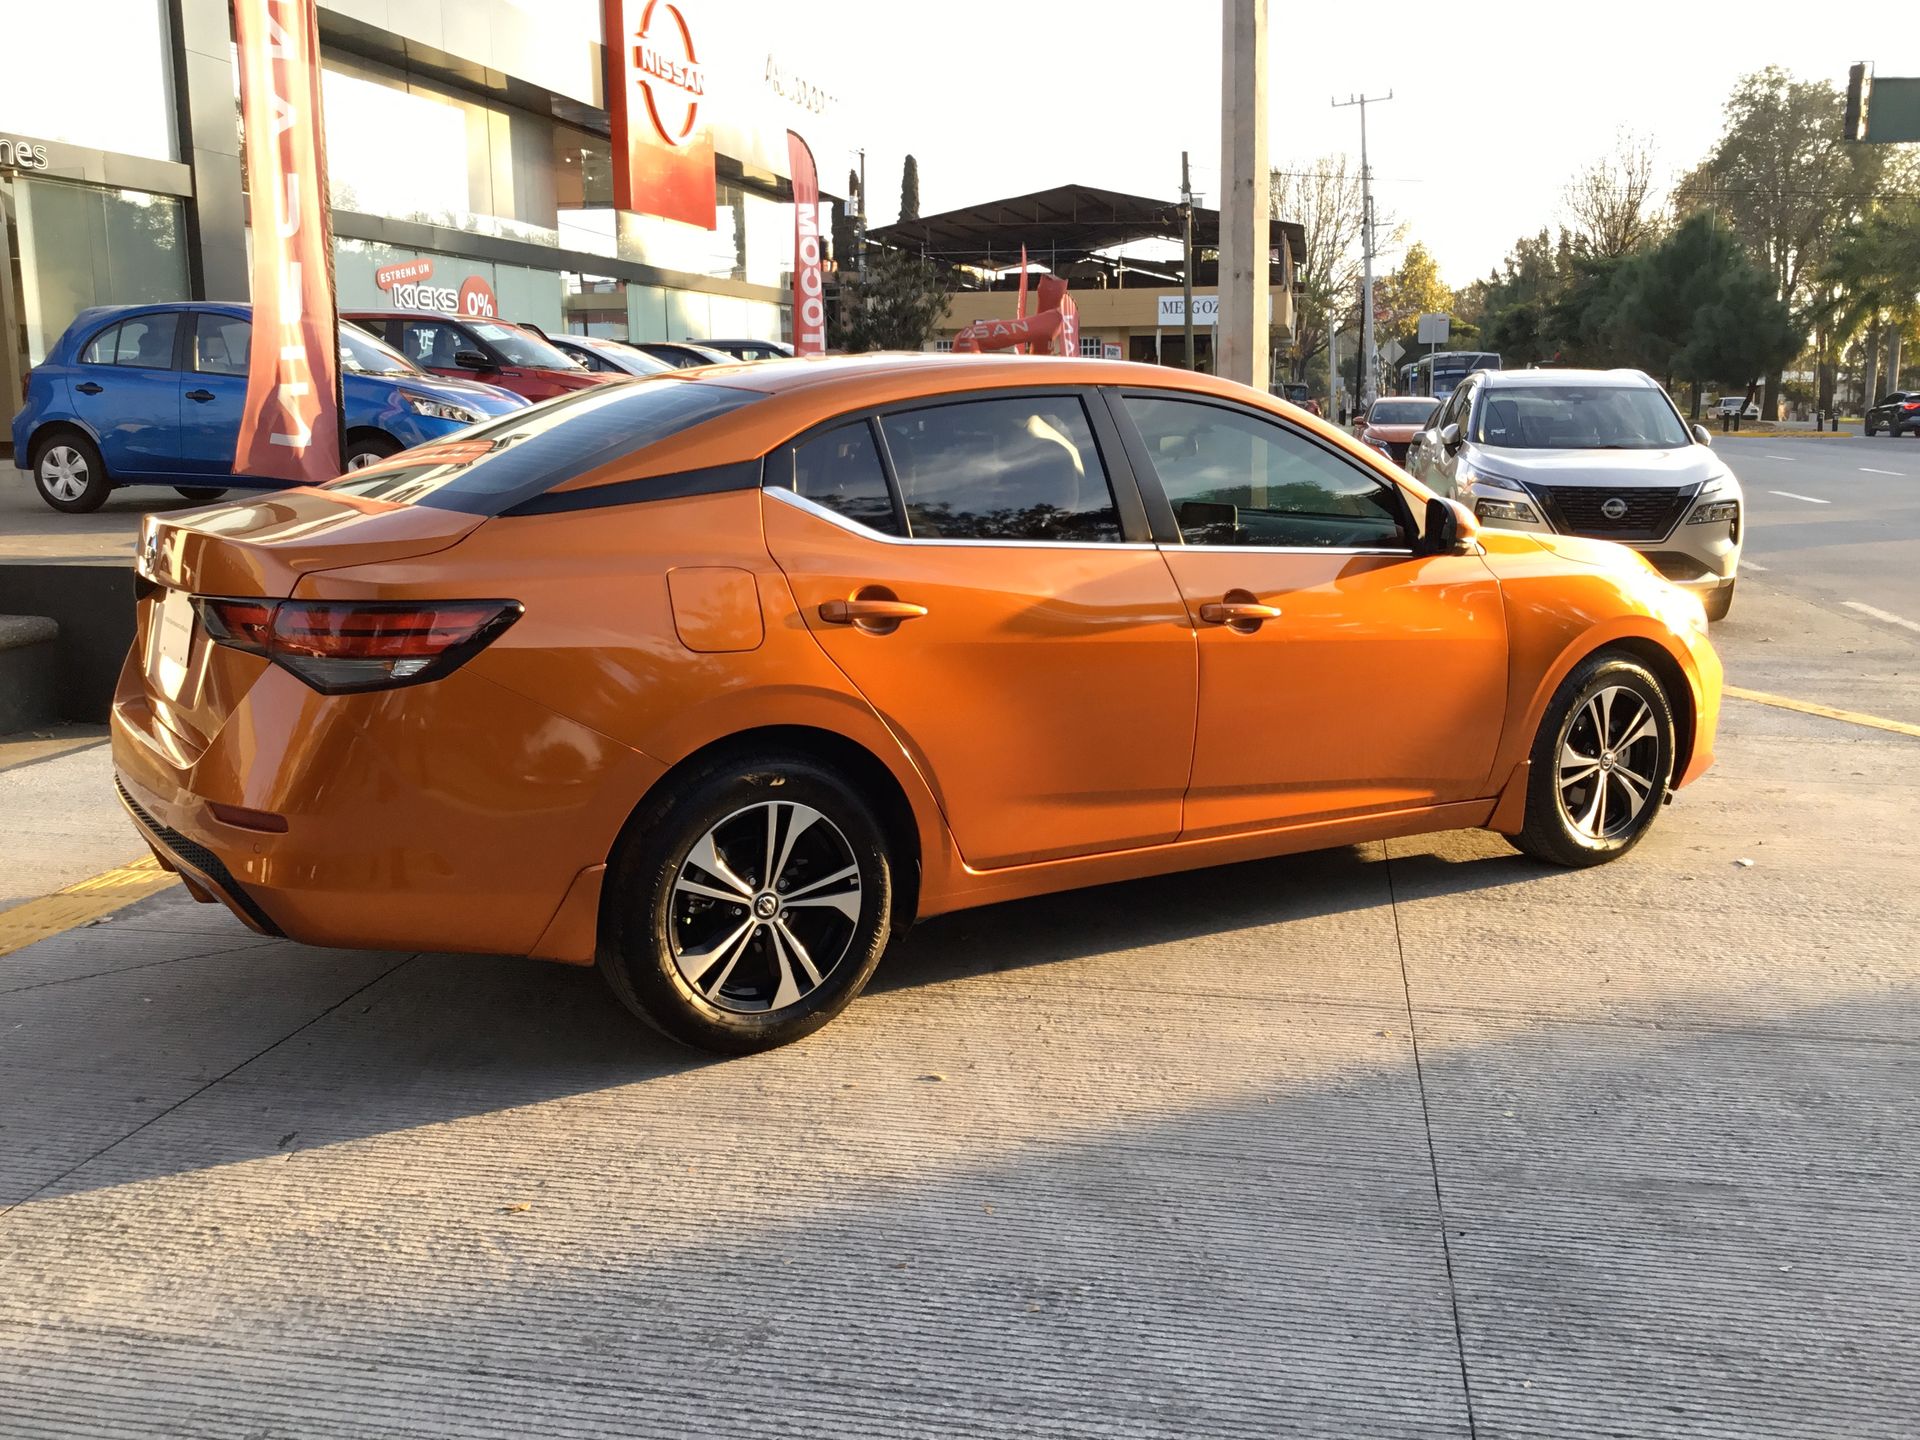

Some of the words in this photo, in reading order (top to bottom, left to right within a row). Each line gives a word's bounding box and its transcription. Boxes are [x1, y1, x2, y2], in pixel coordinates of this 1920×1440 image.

[380, 266, 417, 283] ESTRENA
[418, 263, 430, 274] UN
[394, 284, 459, 311] KICKS
[467, 291, 493, 317] 0%
